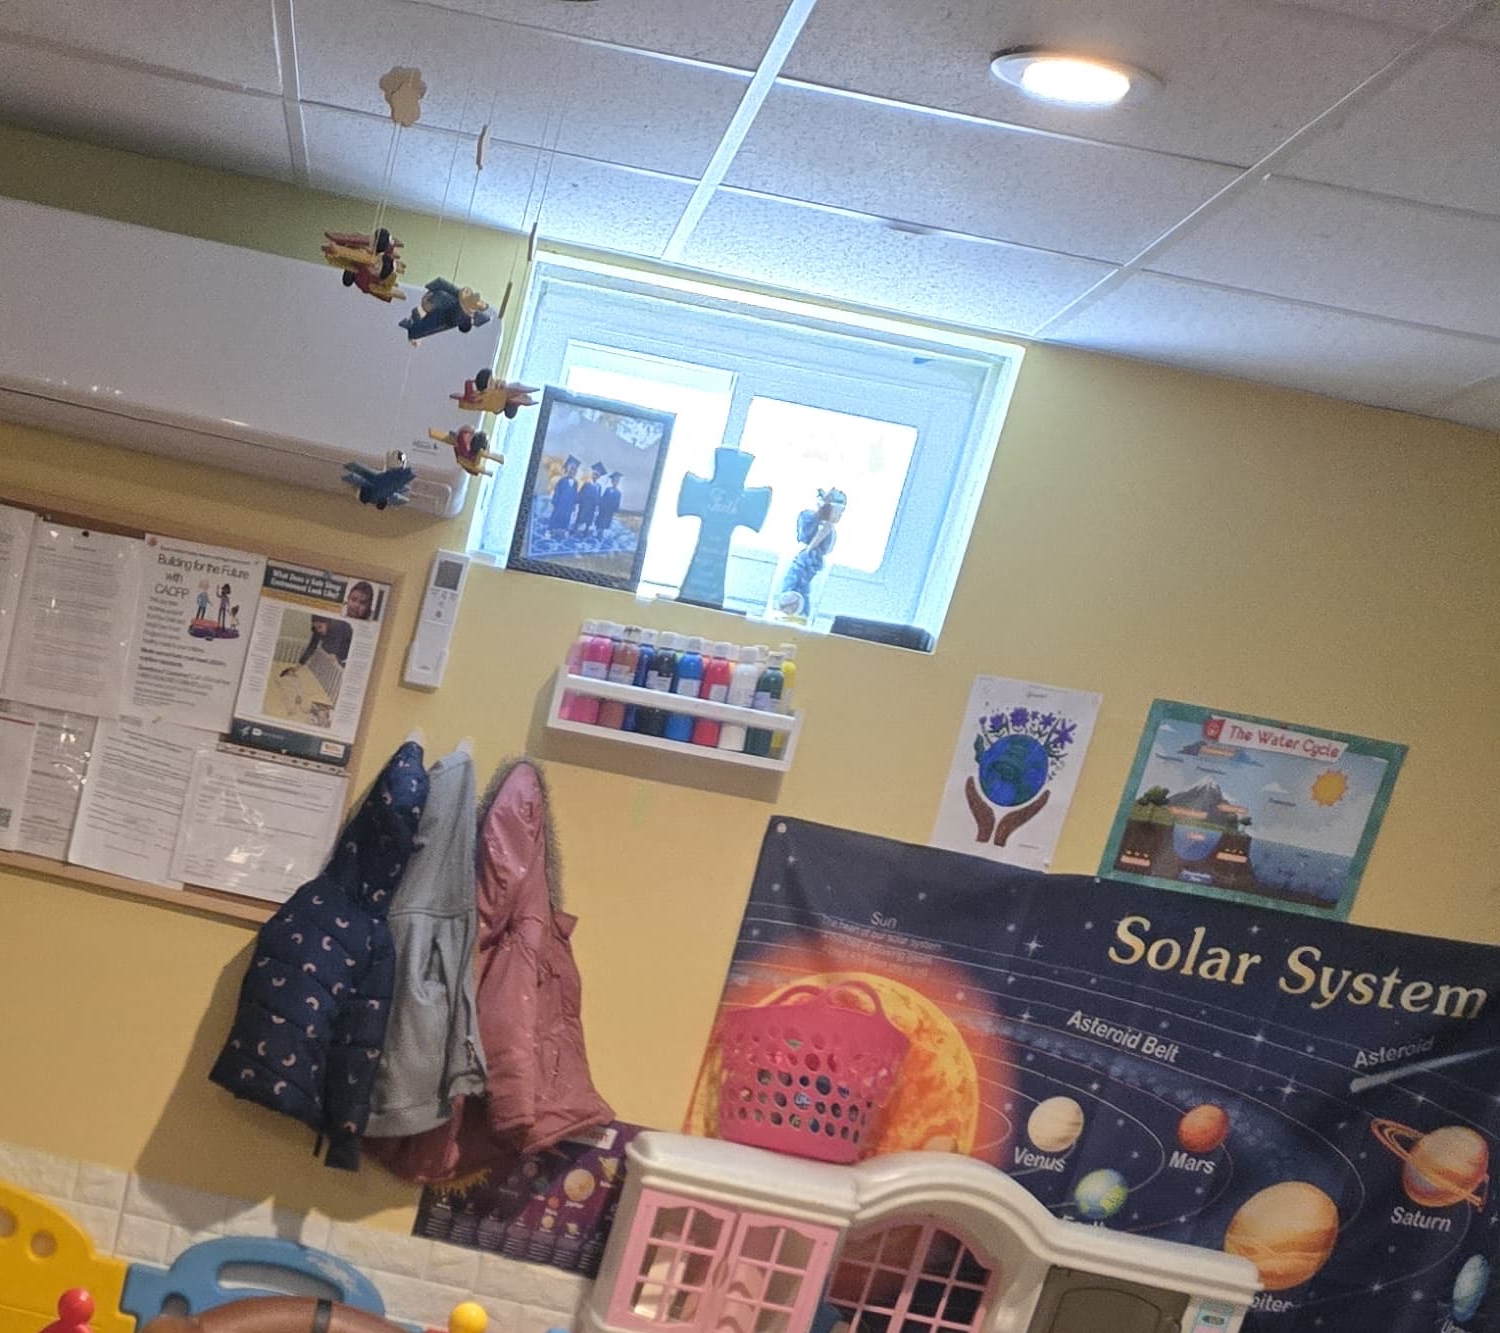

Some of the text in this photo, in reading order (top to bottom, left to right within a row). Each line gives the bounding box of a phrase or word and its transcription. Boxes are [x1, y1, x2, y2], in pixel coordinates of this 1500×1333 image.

[158, 553, 193, 571] Building
[194, 560, 206, 572] for
[206, 563, 221, 575] the
[222, 566, 250, 580] Future
[165, 572, 183, 583] with
[155, 583, 189, 598] CACFP
[1229, 725, 1340, 758] The Water Cycle
[870, 911, 898, 929] Sun
[1107, 916, 1488, 1020] Solar System
[1067, 1010, 1180, 1063] Asteroid Belt
[1353, 1035, 1436, 1069] Asteroid
[1014, 1146, 1066, 1172] Venus
[1169, 1151, 1216, 1175] Mars
[1390, 1206, 1452, 1233] Saturn
[1251, 1292, 1295, 1313] piter
